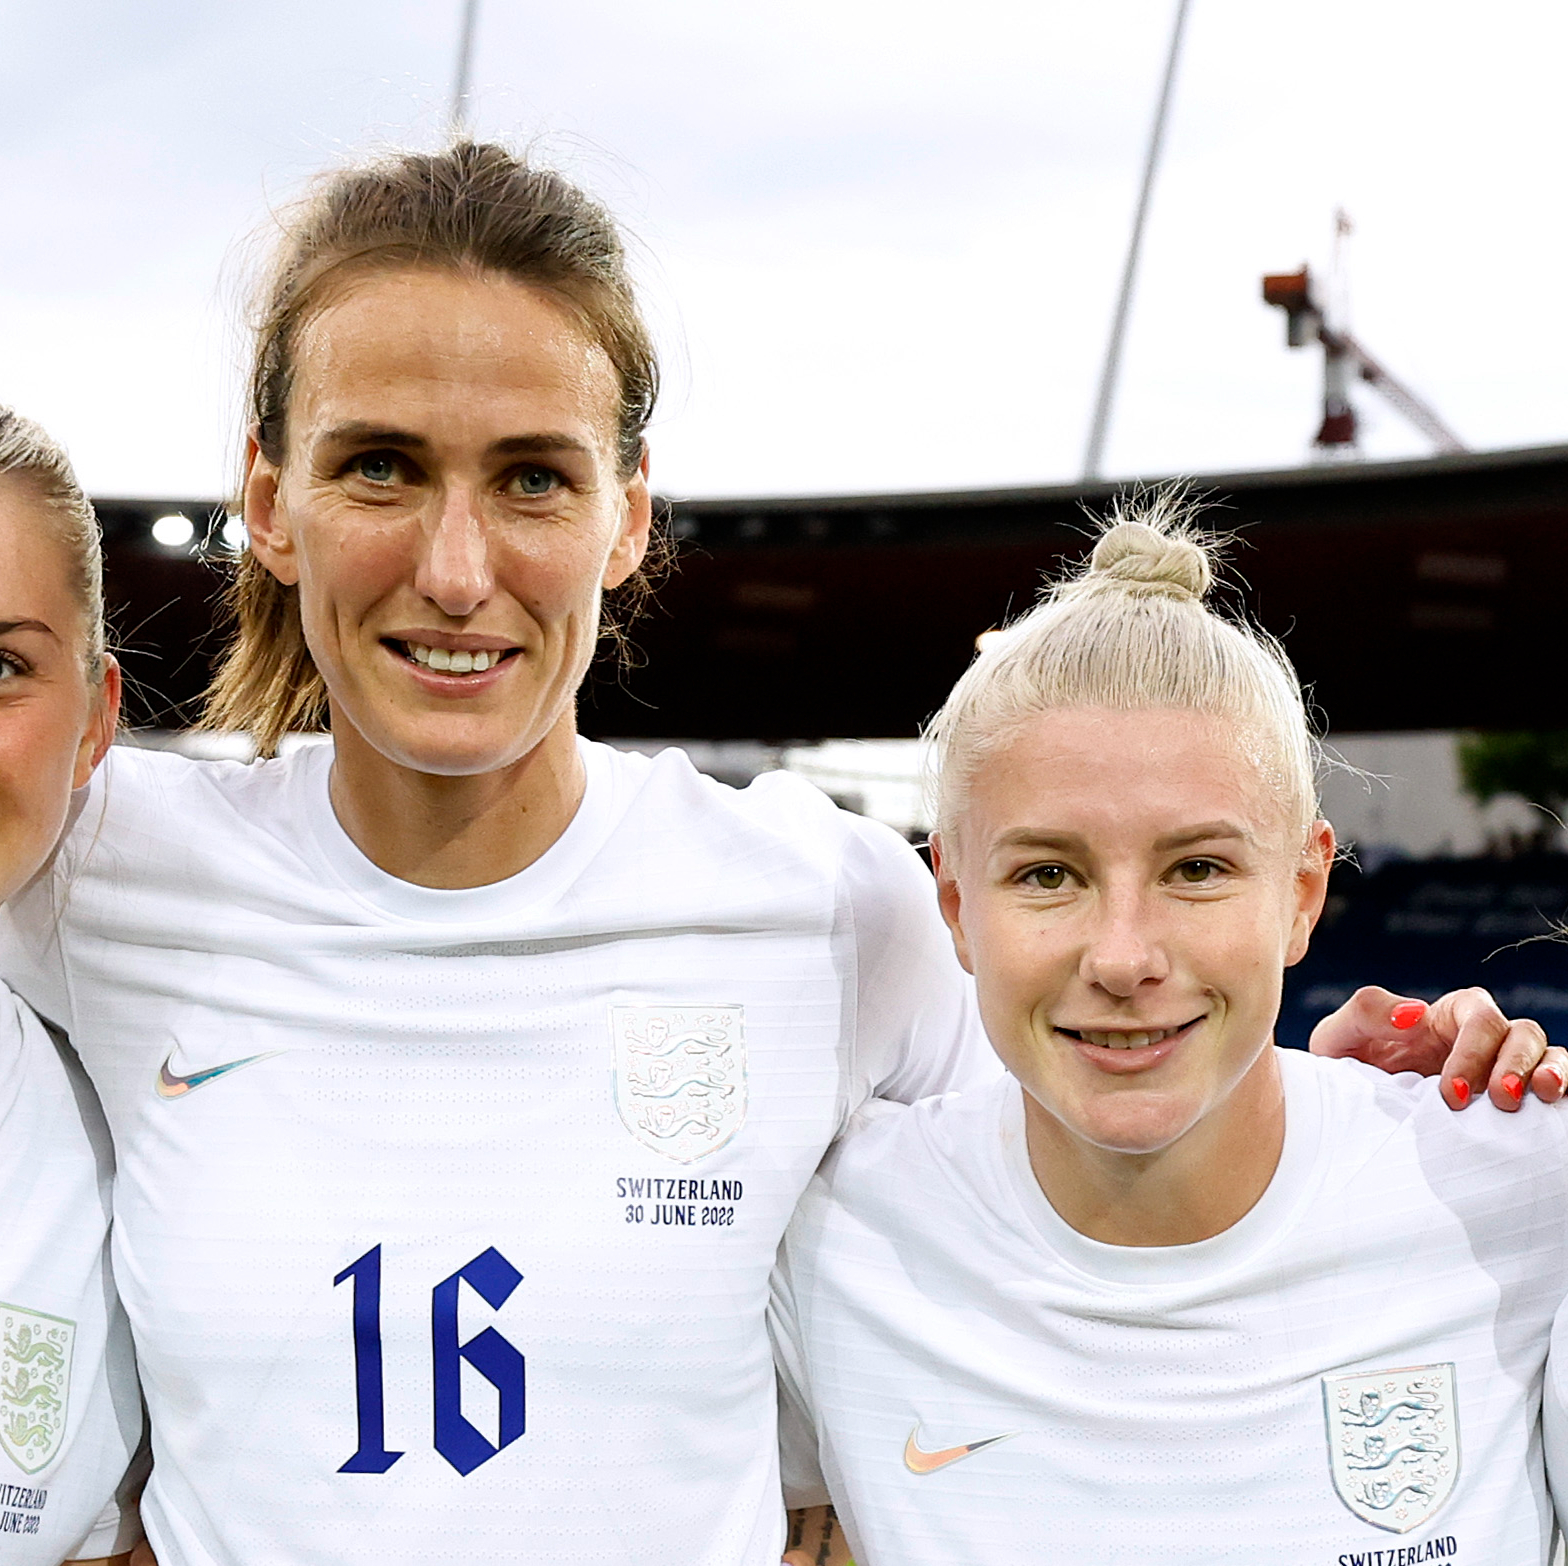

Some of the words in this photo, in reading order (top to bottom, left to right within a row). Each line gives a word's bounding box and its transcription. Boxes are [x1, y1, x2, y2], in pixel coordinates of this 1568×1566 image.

[616, 1177, 744, 1201] SWITZERLAND
[625, 1204, 644, 1224] 30
[650, 1204, 696, 1226] JUNE
[701, 1206, 735, 1226] 2022
[334, 1243, 526, 1477] 16
